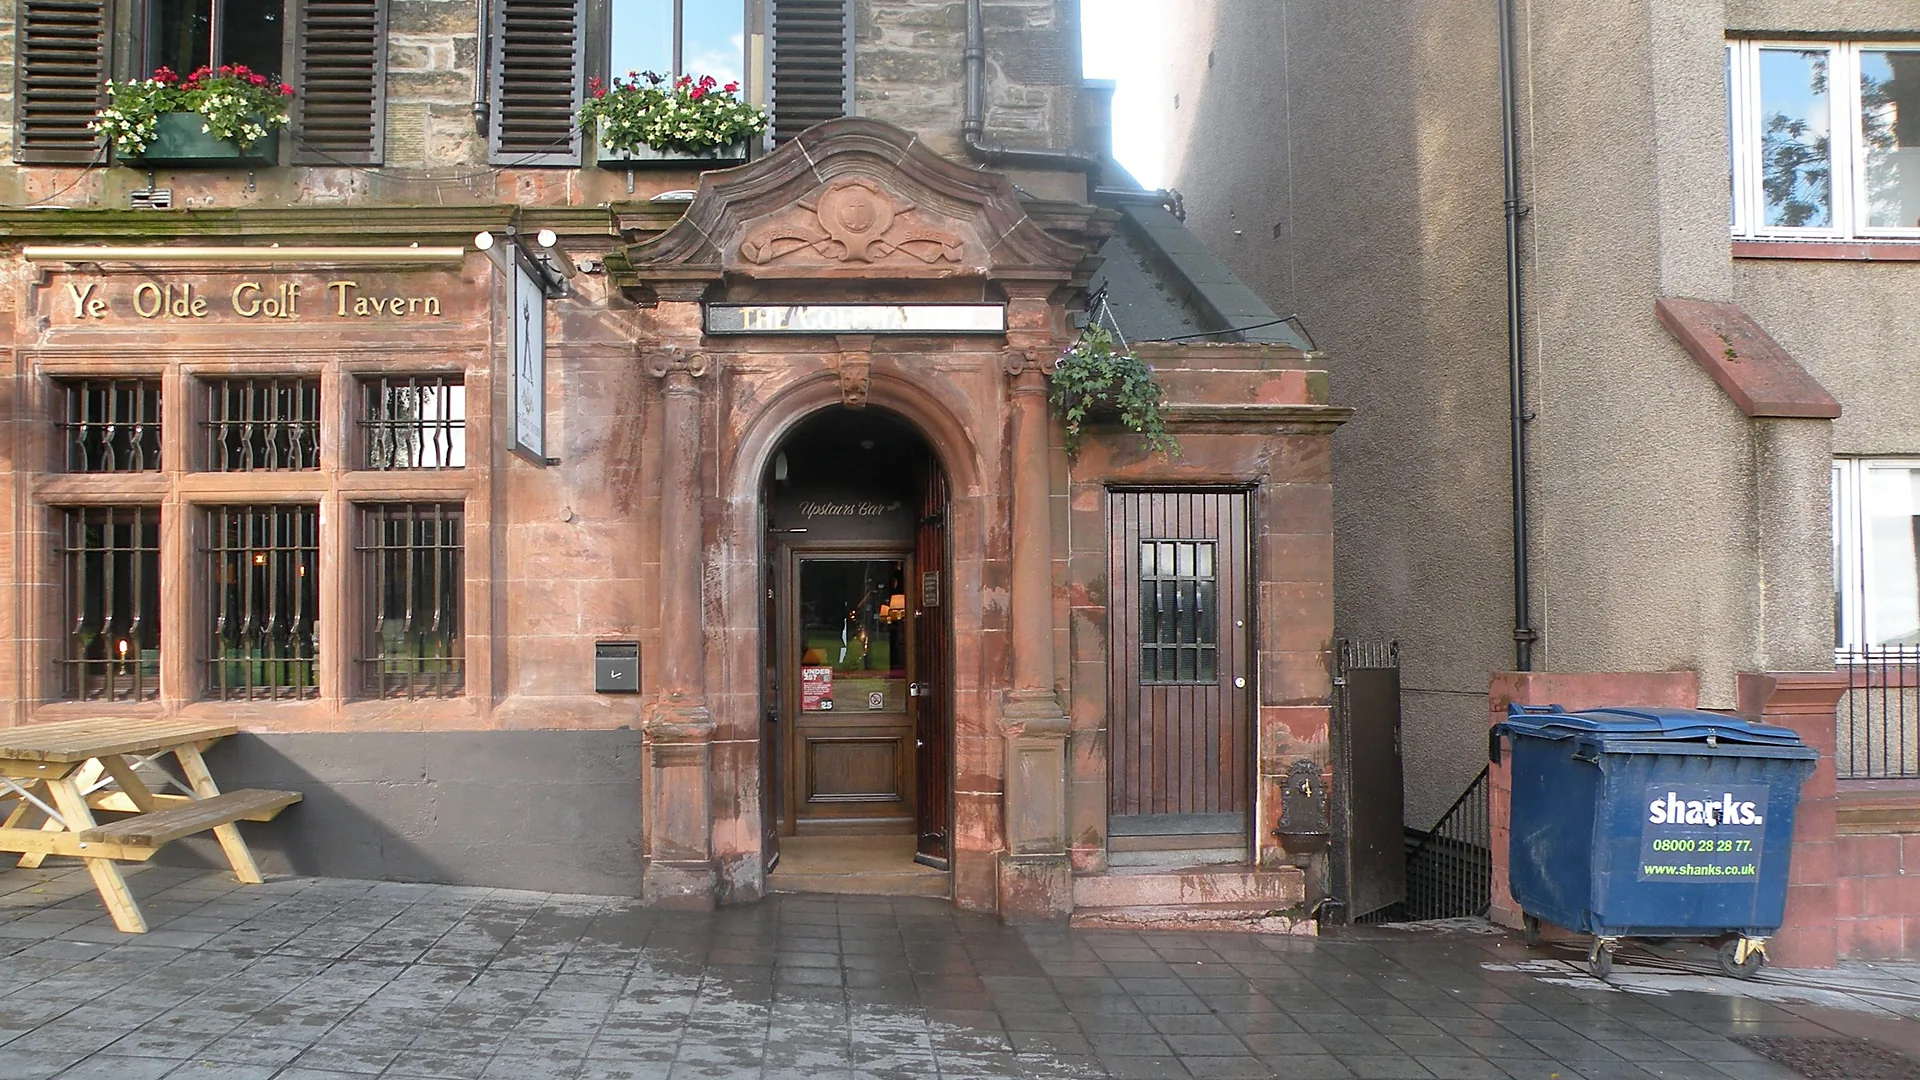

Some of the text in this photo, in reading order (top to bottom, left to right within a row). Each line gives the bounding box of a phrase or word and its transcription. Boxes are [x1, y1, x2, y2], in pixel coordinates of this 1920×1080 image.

[66, 281, 441, 319] Ye Olde Golf Tavern
[739, 306, 790, 330] THE
[799, 501, 884, 520] Upstairs Bar
[820, 701, 832, 710] 25
[1653, 839, 1753, 852] 08000 28 28 77.
[1644, 863, 1755, 876] www.shanks.co.uk
